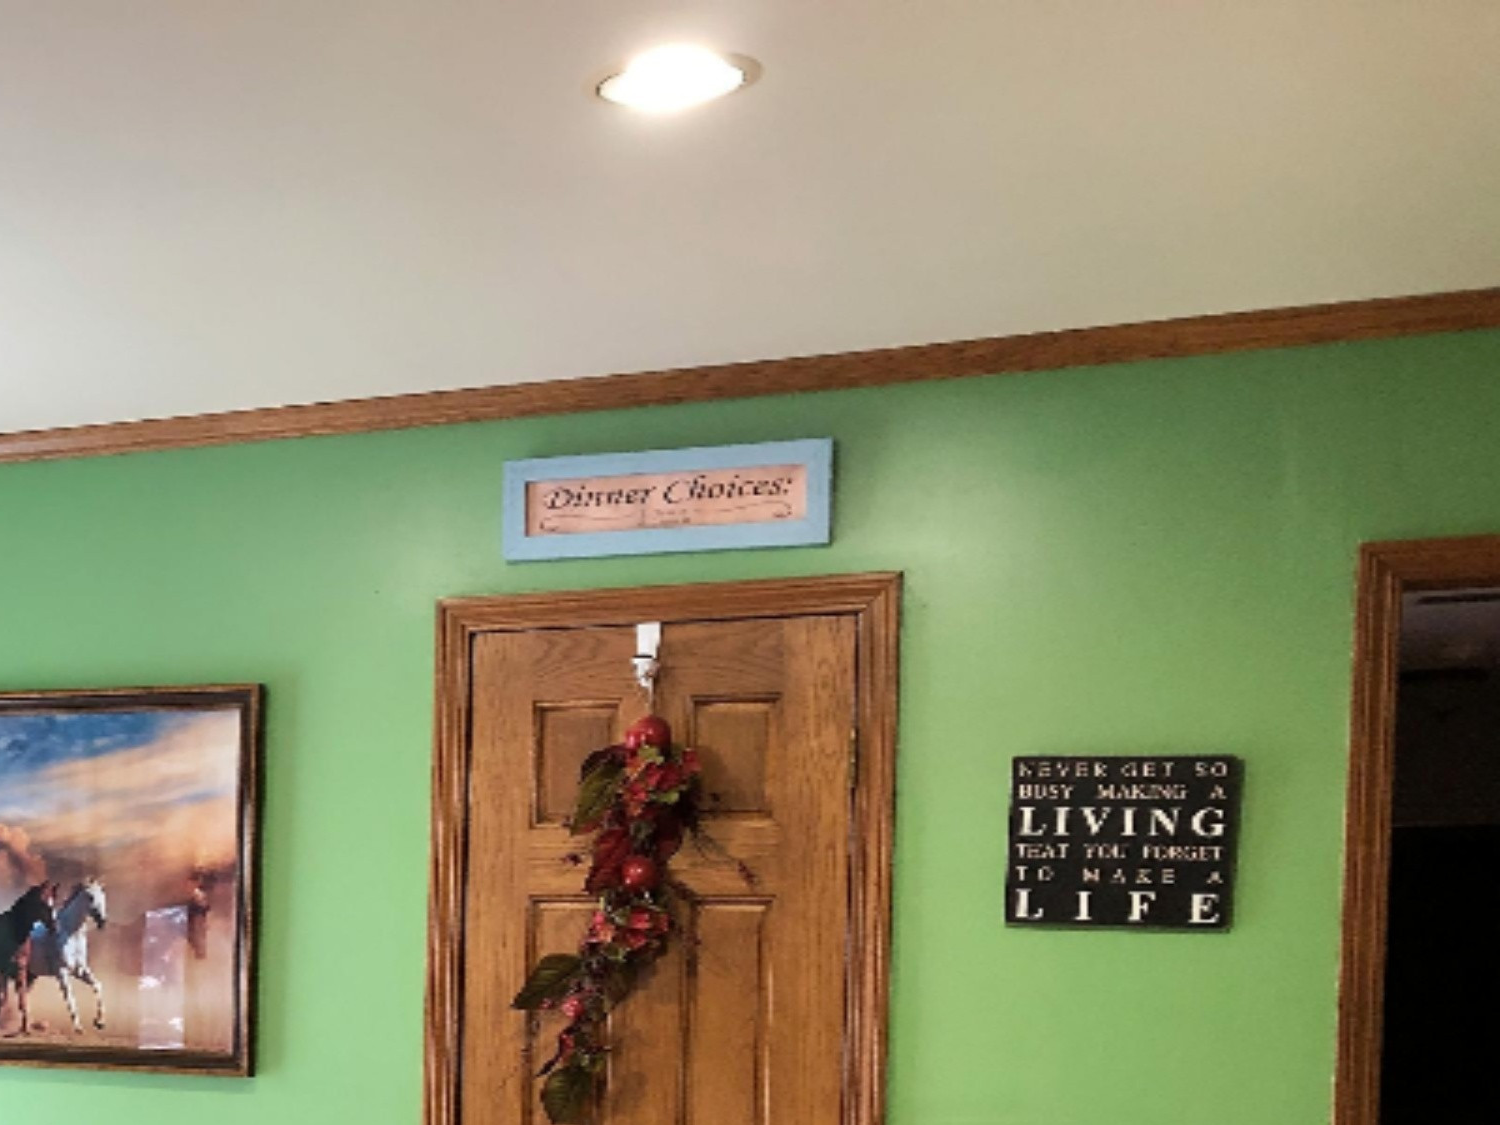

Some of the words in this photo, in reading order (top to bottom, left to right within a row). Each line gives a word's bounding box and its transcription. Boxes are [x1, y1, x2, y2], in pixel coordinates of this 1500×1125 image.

[544, 484, 656, 510] Dinner
[1018, 762, 1107, 777] NEVER
[1120, 762, 1174, 778] GET
[1195, 762, 1228, 776] SO
[1018, 784, 1075, 799] BUSY
[1097, 784, 1189, 799] MAKING
[1209, 786, 1227, 799] A
[1018, 806, 1226, 837] LIVING
[1015, 844, 1069, 859] THAT
[1083, 844, 1129, 859] YOU
[1142, 845, 1223, 861] FORGET
[1015, 866, 1054, 882] TO
[1082, 868, 1176, 884] MAKE
[1207, 871, 1223, 884] A
[1015, 888, 1220, 923] LIFE
